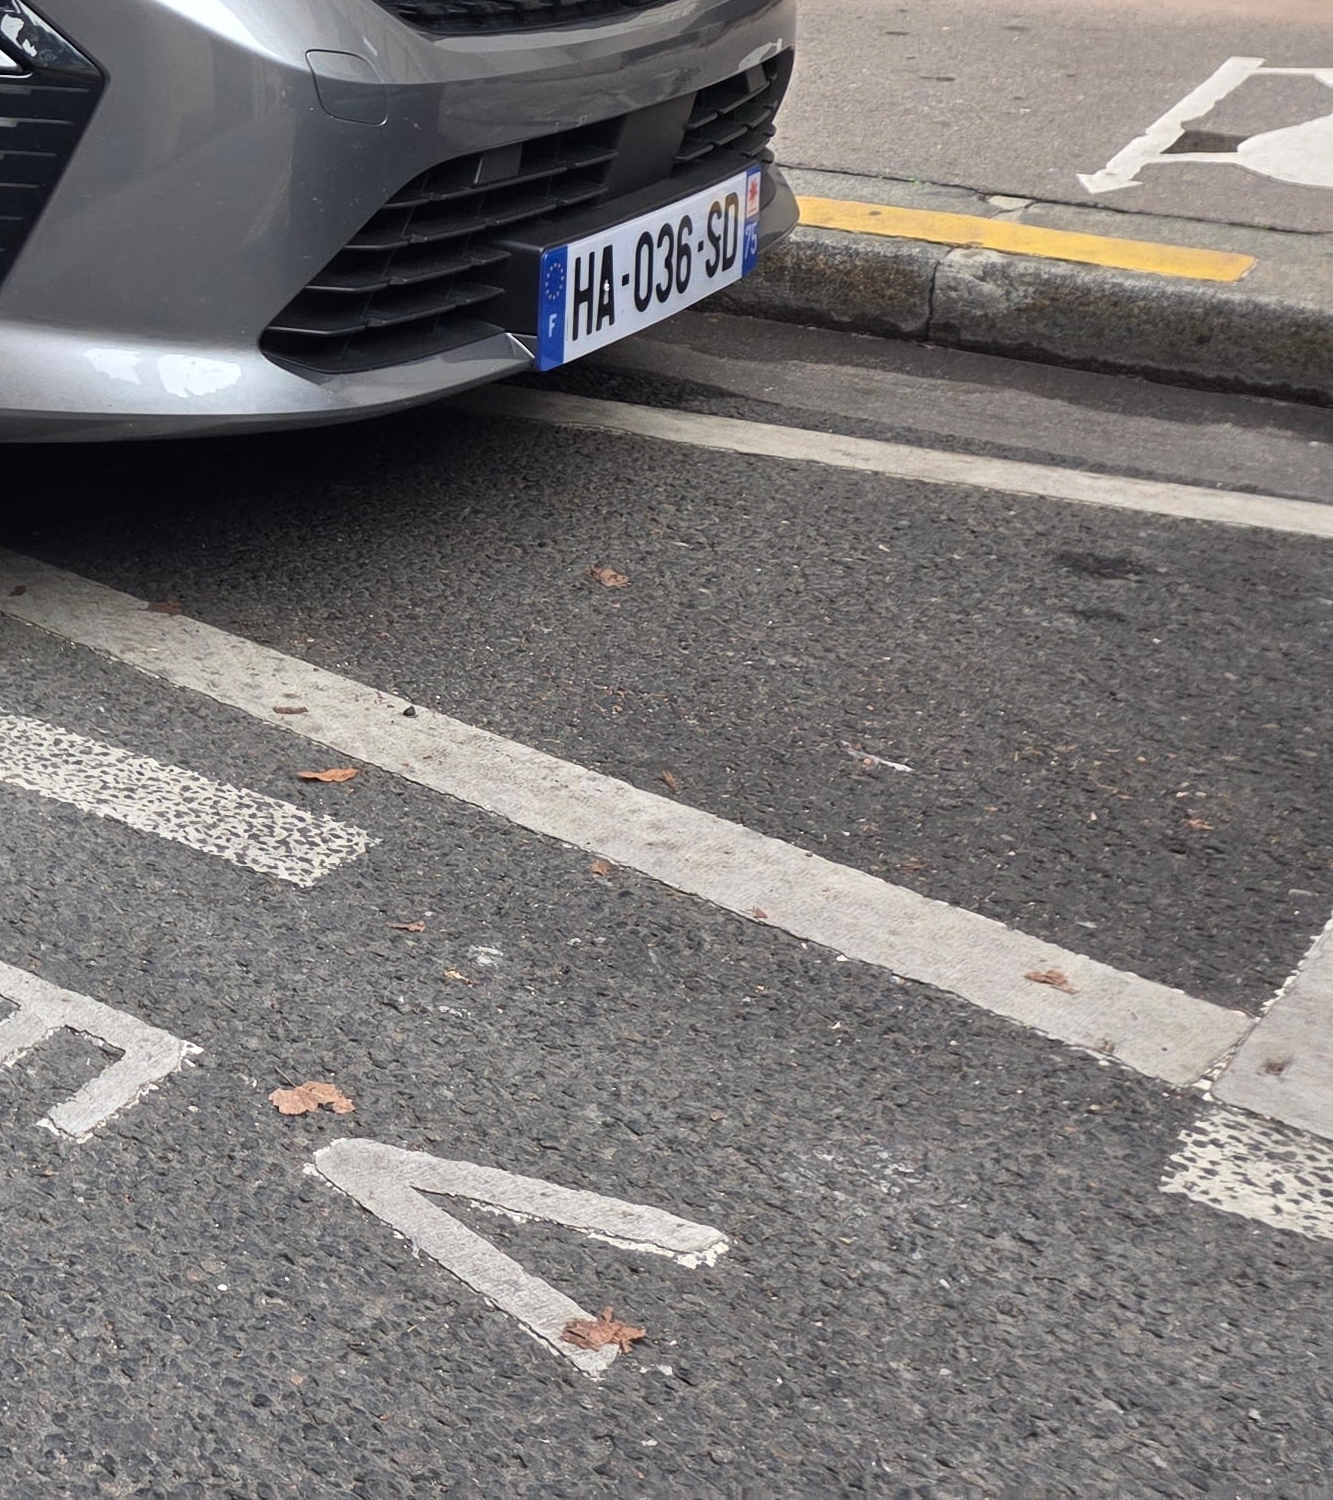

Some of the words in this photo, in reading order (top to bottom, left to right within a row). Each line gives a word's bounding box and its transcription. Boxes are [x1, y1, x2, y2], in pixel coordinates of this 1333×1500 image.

[548, 312, 558, 339] F
[572, 191, 740, 342] HA-036-SD
[744, 224, 759, 262] 75
